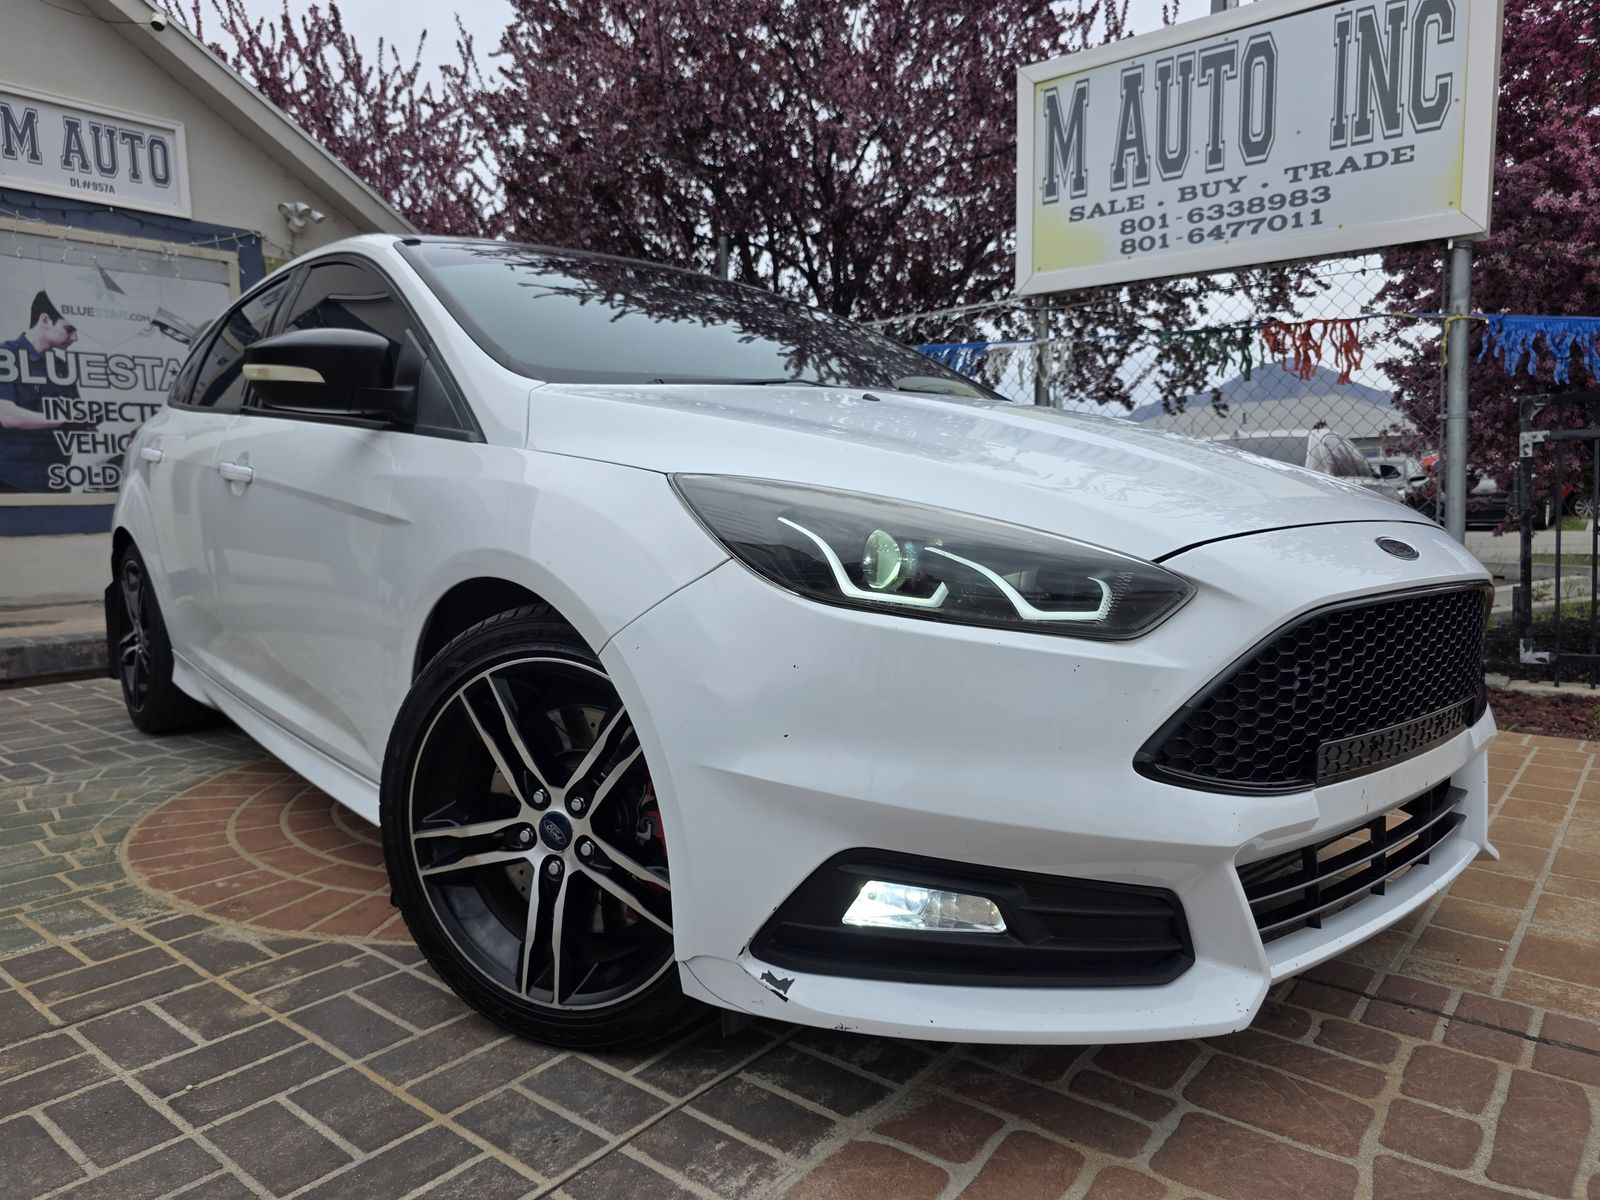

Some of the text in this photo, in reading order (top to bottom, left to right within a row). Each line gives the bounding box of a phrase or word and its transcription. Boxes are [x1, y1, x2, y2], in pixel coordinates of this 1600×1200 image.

[1042, 0, 1456, 204] M AUTO INC
[0, 103, 172, 188] M AUTO
[1068, 145, 1415, 223] SALE BUY TRADE
[1119, 186, 1331, 236] 801-6338983
[1119, 208, 1323, 255] 801-6477011
[49, 463, 121, 489] SOLD
